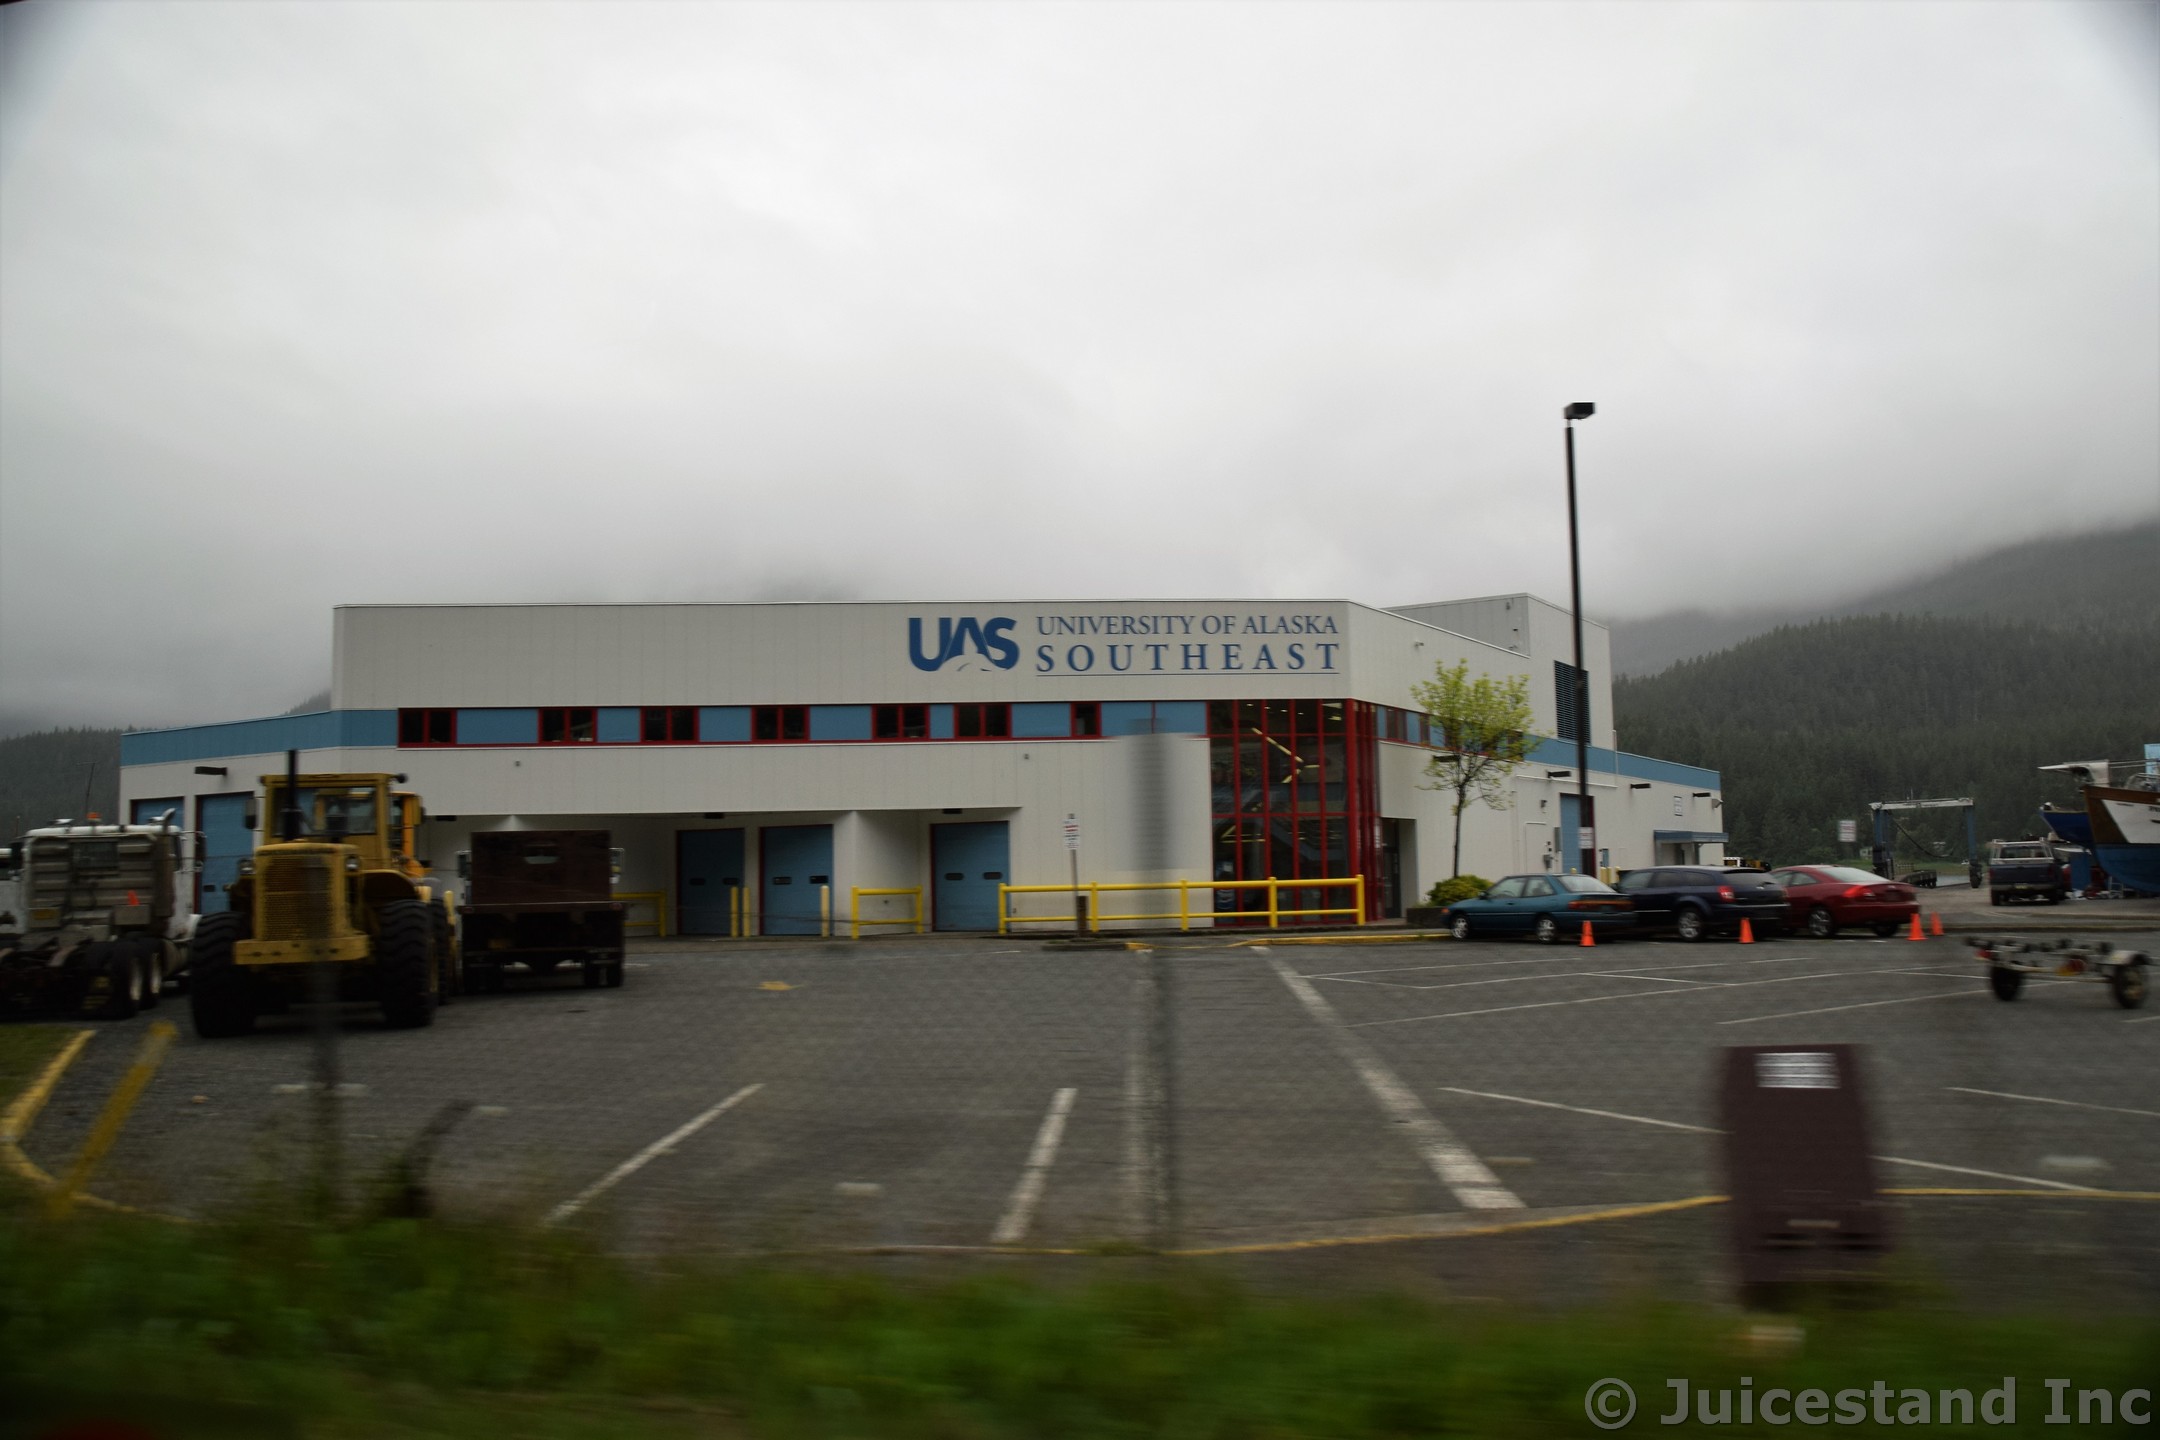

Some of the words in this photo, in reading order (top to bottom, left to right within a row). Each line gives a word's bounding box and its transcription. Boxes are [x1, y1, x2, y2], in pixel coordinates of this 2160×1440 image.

[1037, 615, 1196, 635] UNIVERSITY
[1202, 615, 1237, 634] OF
[1242, 615, 1338, 634] ALASKA
[908, 617, 1020, 672] UAS
[1036, 643, 1339, 672] SOUTHEAST
